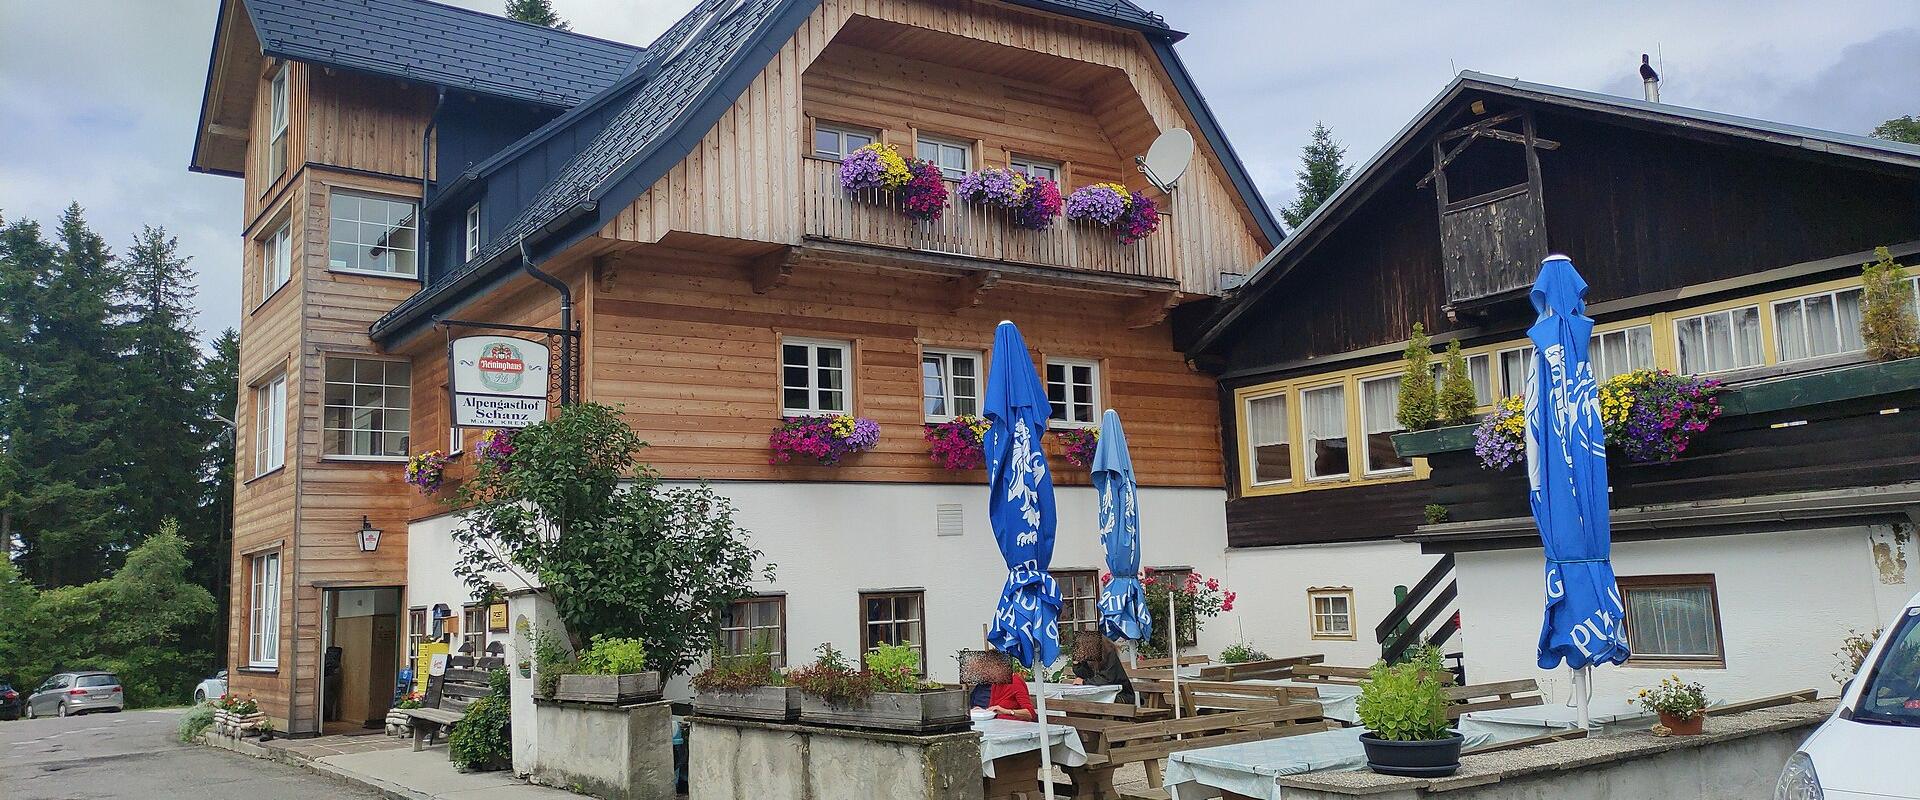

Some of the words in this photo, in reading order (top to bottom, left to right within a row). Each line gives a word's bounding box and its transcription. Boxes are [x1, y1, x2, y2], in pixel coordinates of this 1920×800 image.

[480, 360, 522, 370] Reininghaus
[463, 397, 539, 411] Alpengasthof
[475, 409, 529, 420] Schanz
